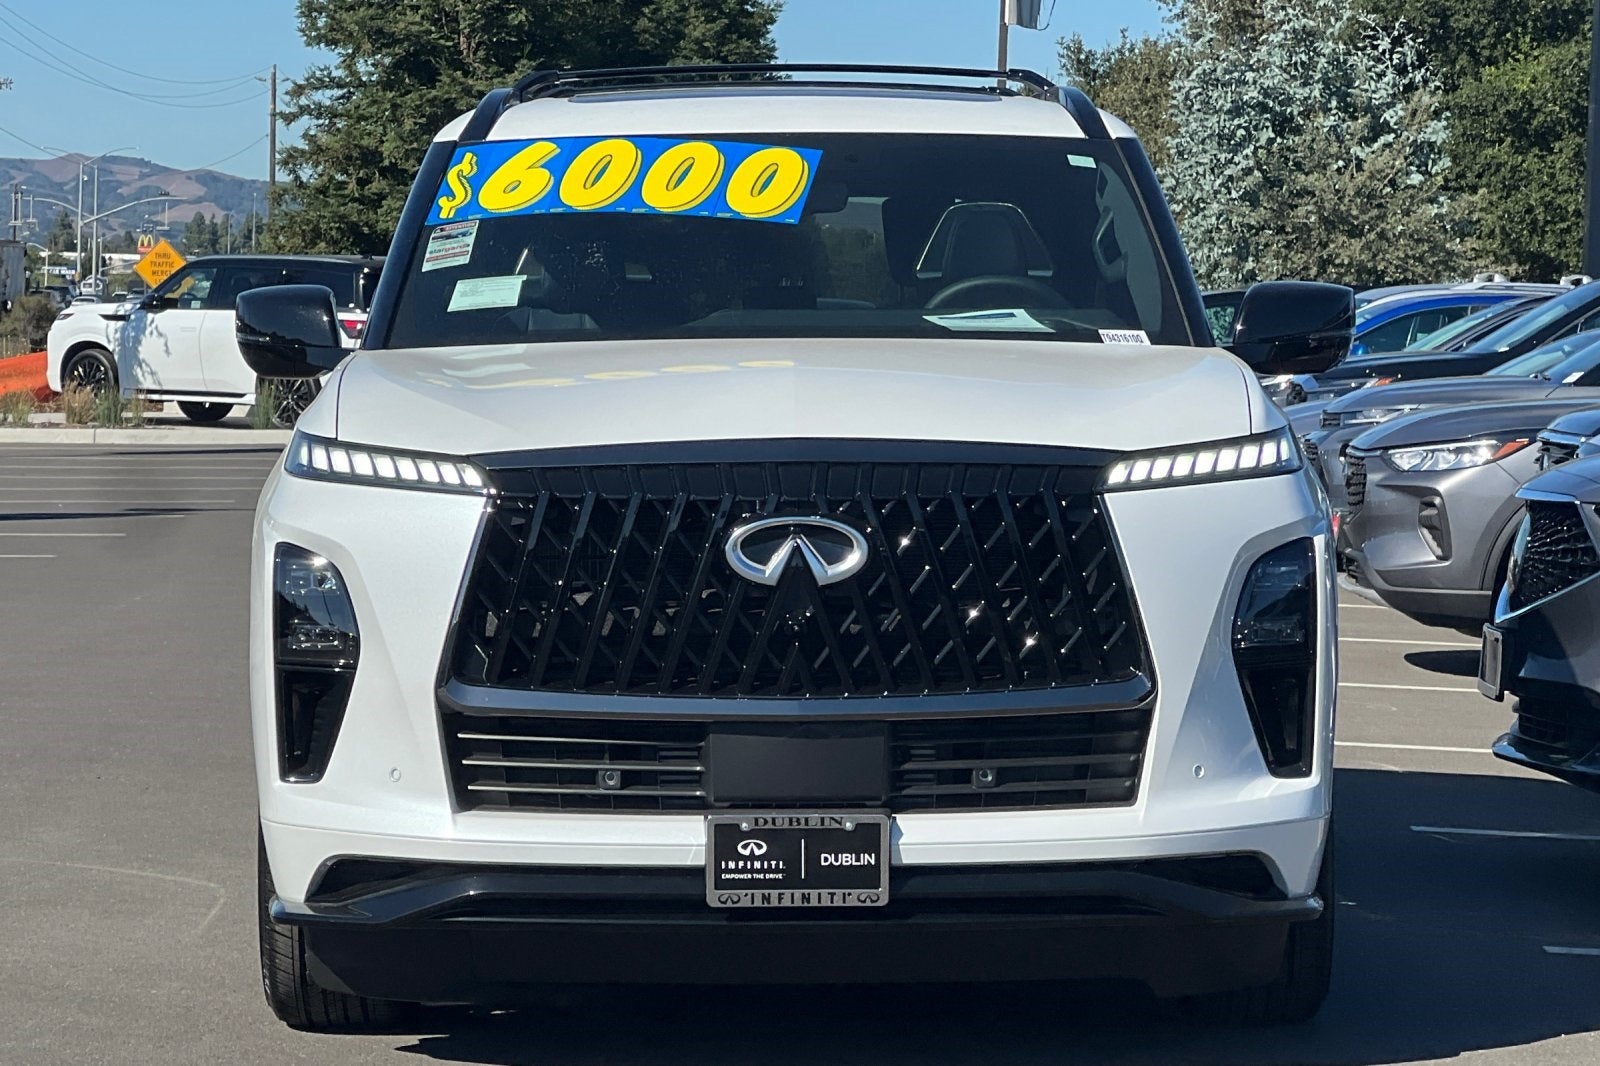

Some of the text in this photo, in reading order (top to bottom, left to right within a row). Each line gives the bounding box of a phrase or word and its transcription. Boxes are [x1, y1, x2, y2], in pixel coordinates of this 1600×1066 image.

[438, 138, 809, 219] $6000
[155, 252, 171, 260] THRU
[150, 260, 175, 269] TRAFFIC
[754, 816, 844, 827] DUBLIN
[721, 860, 784, 869] INFINITI
[820, 853, 876, 866] DUBLIN
[751, 892, 847, 905] INFINITI
